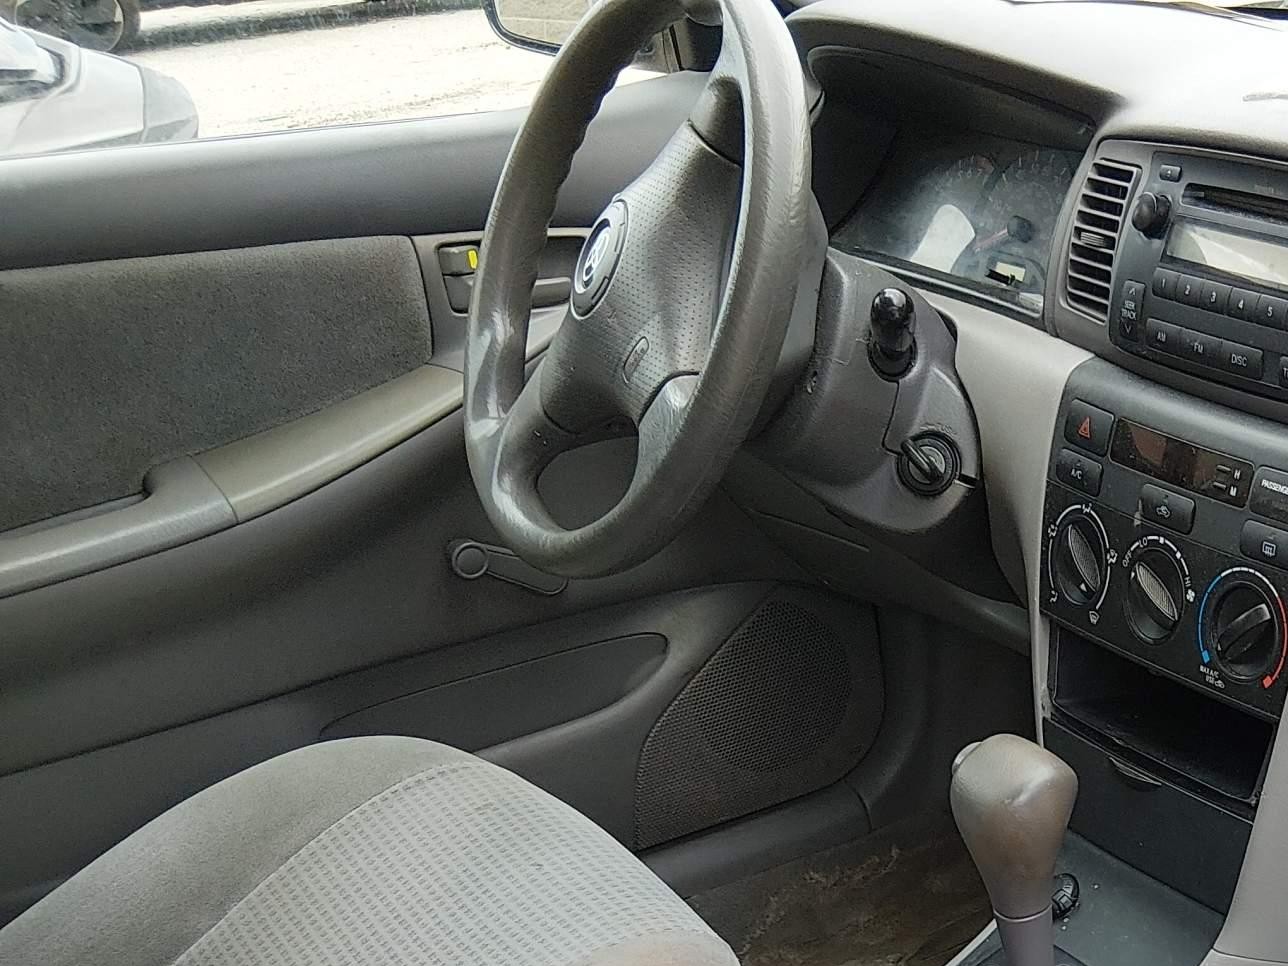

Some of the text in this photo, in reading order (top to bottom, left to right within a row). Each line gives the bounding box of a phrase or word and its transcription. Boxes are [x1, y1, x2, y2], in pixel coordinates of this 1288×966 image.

[1185, 284, 1191, 295] 2
[1210, 291, 1217, 302] 3
[1238, 299, 1244, 310] 4
[1267, 306, 1273, 317] 5
[1231, 353, 1248, 367] DISC
[1139, 538, 1148, 548] LO
[1122, 551, 1133, 567] OFF
